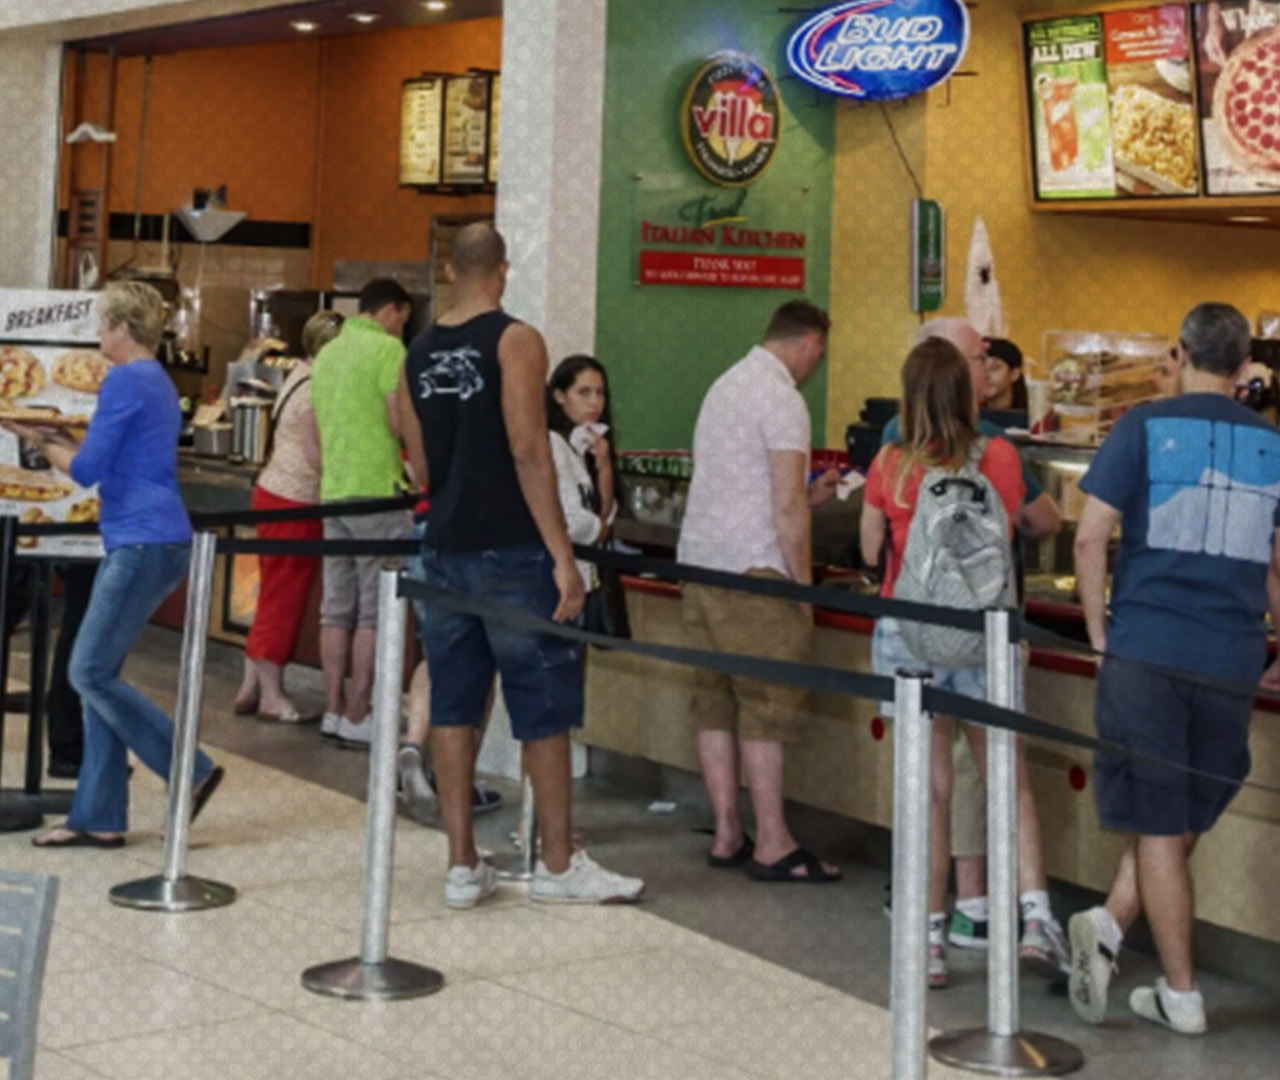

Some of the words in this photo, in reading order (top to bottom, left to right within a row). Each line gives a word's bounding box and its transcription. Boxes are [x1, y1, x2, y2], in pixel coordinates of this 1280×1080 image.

[836, 13, 943, 45] BUD
[1221, 7, 1275, 32] Whole
[814, 41, 958, 71] LIGHT
[691, 96, 775, 143] villa
[641, 220, 716, 246] ITALIAN
[722, 225, 806, 251] KITCHEN
[3, 298, 94, 332] BREAKFAST
